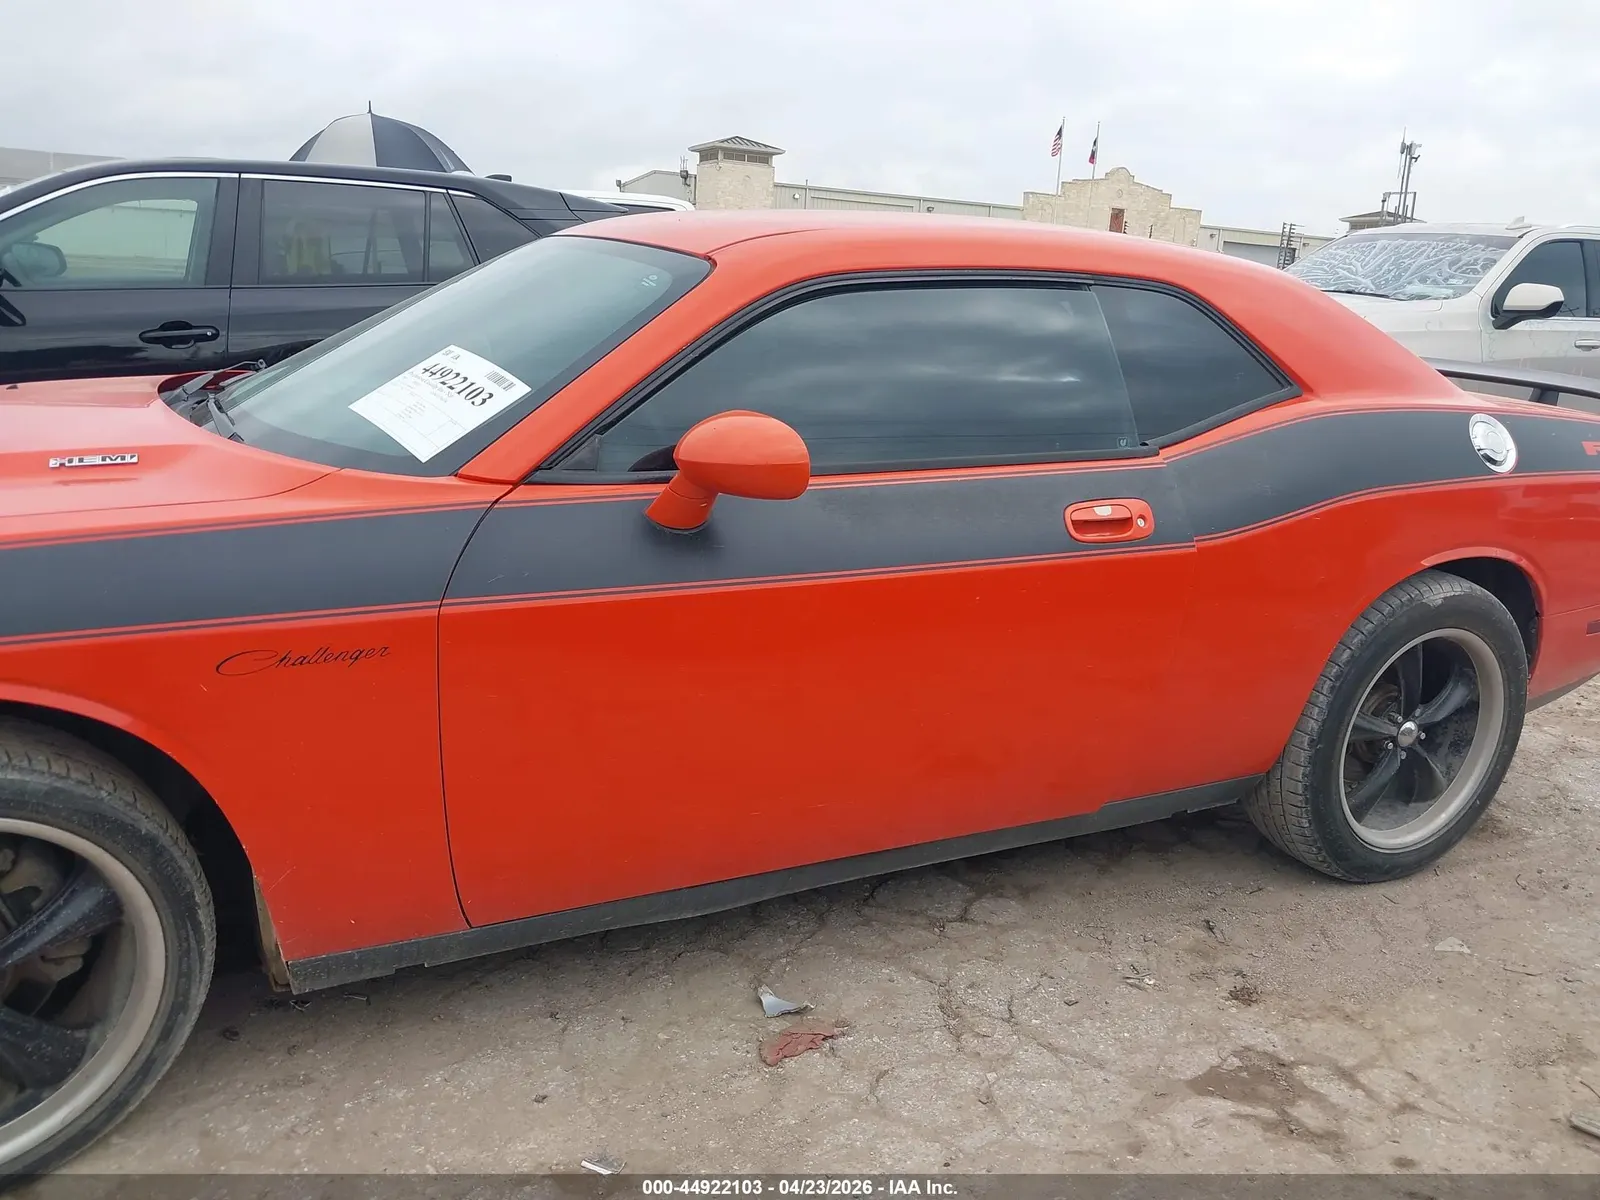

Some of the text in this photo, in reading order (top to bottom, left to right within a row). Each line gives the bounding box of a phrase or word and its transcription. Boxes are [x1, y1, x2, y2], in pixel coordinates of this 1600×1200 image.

[421, 362, 494, 407] 44922103
[48, 453, 138, 468] HEMI
[216, 646, 390, 676] Challenger
